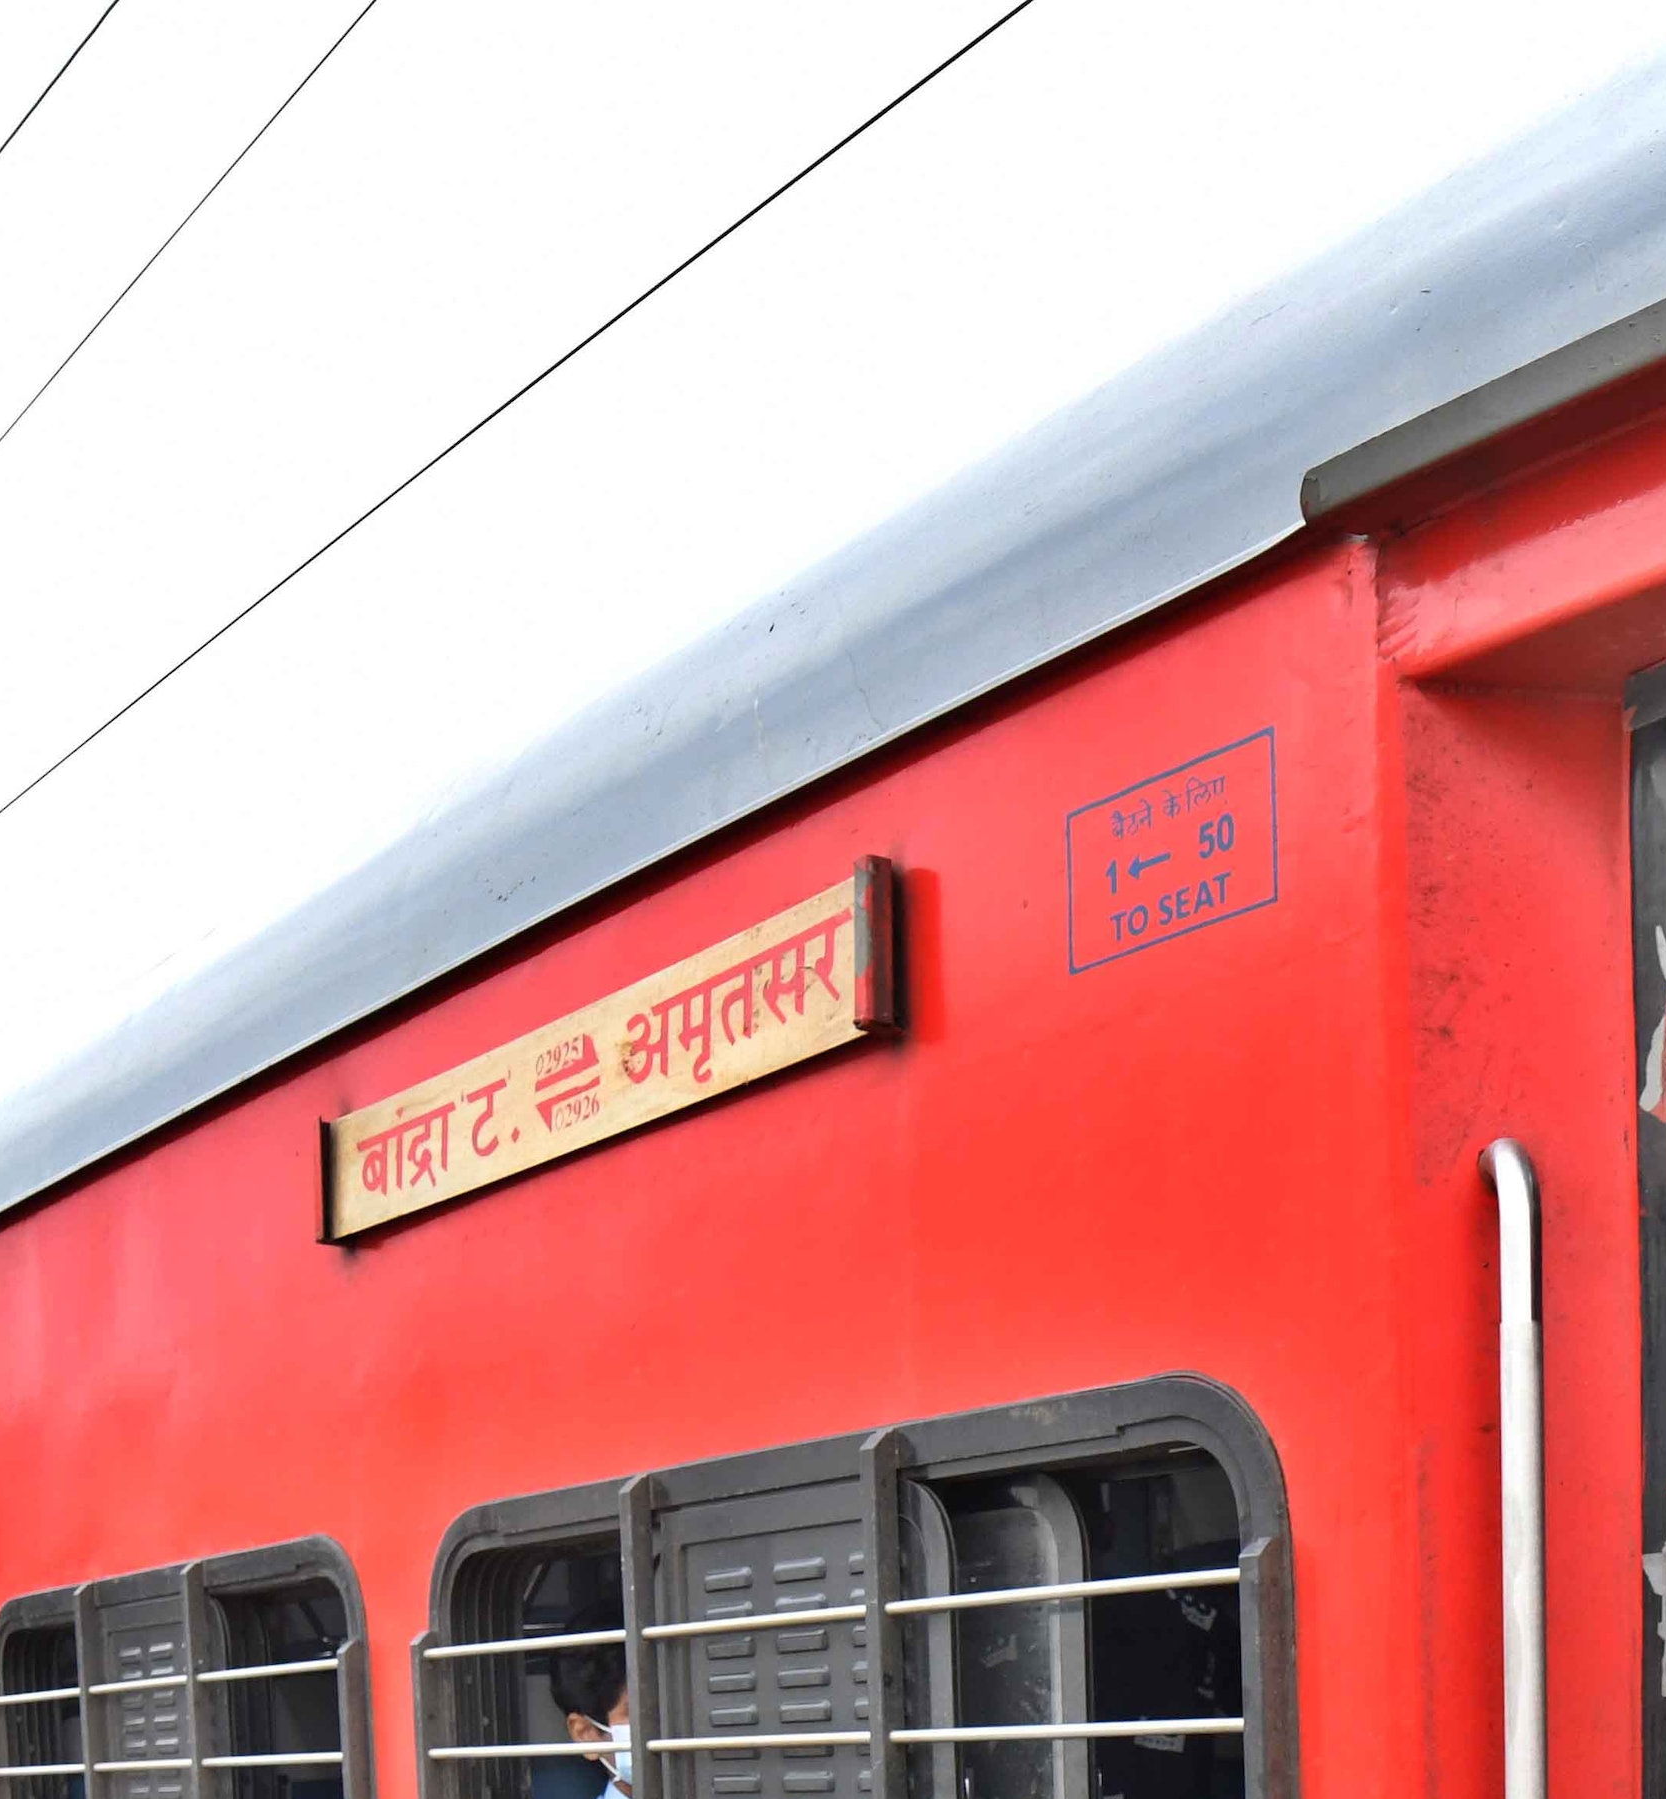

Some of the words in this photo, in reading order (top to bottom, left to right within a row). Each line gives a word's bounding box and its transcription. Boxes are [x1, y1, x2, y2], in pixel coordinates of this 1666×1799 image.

[1162, 789, 1182, 818] के
[1105, 859, 1118, 895] 1
[1198, 812, 1235, 859] 50
[1109, 904, 1150, 942] TO
[1158, 871, 1232, 926] SEAT
[356, 1100, 457, 1195] बांद्रा
[625, 907, 854, 1084] अमृतसर
[535, 1035, 580, 1077] 02925
[555, 1091, 601, 1132] 02926
